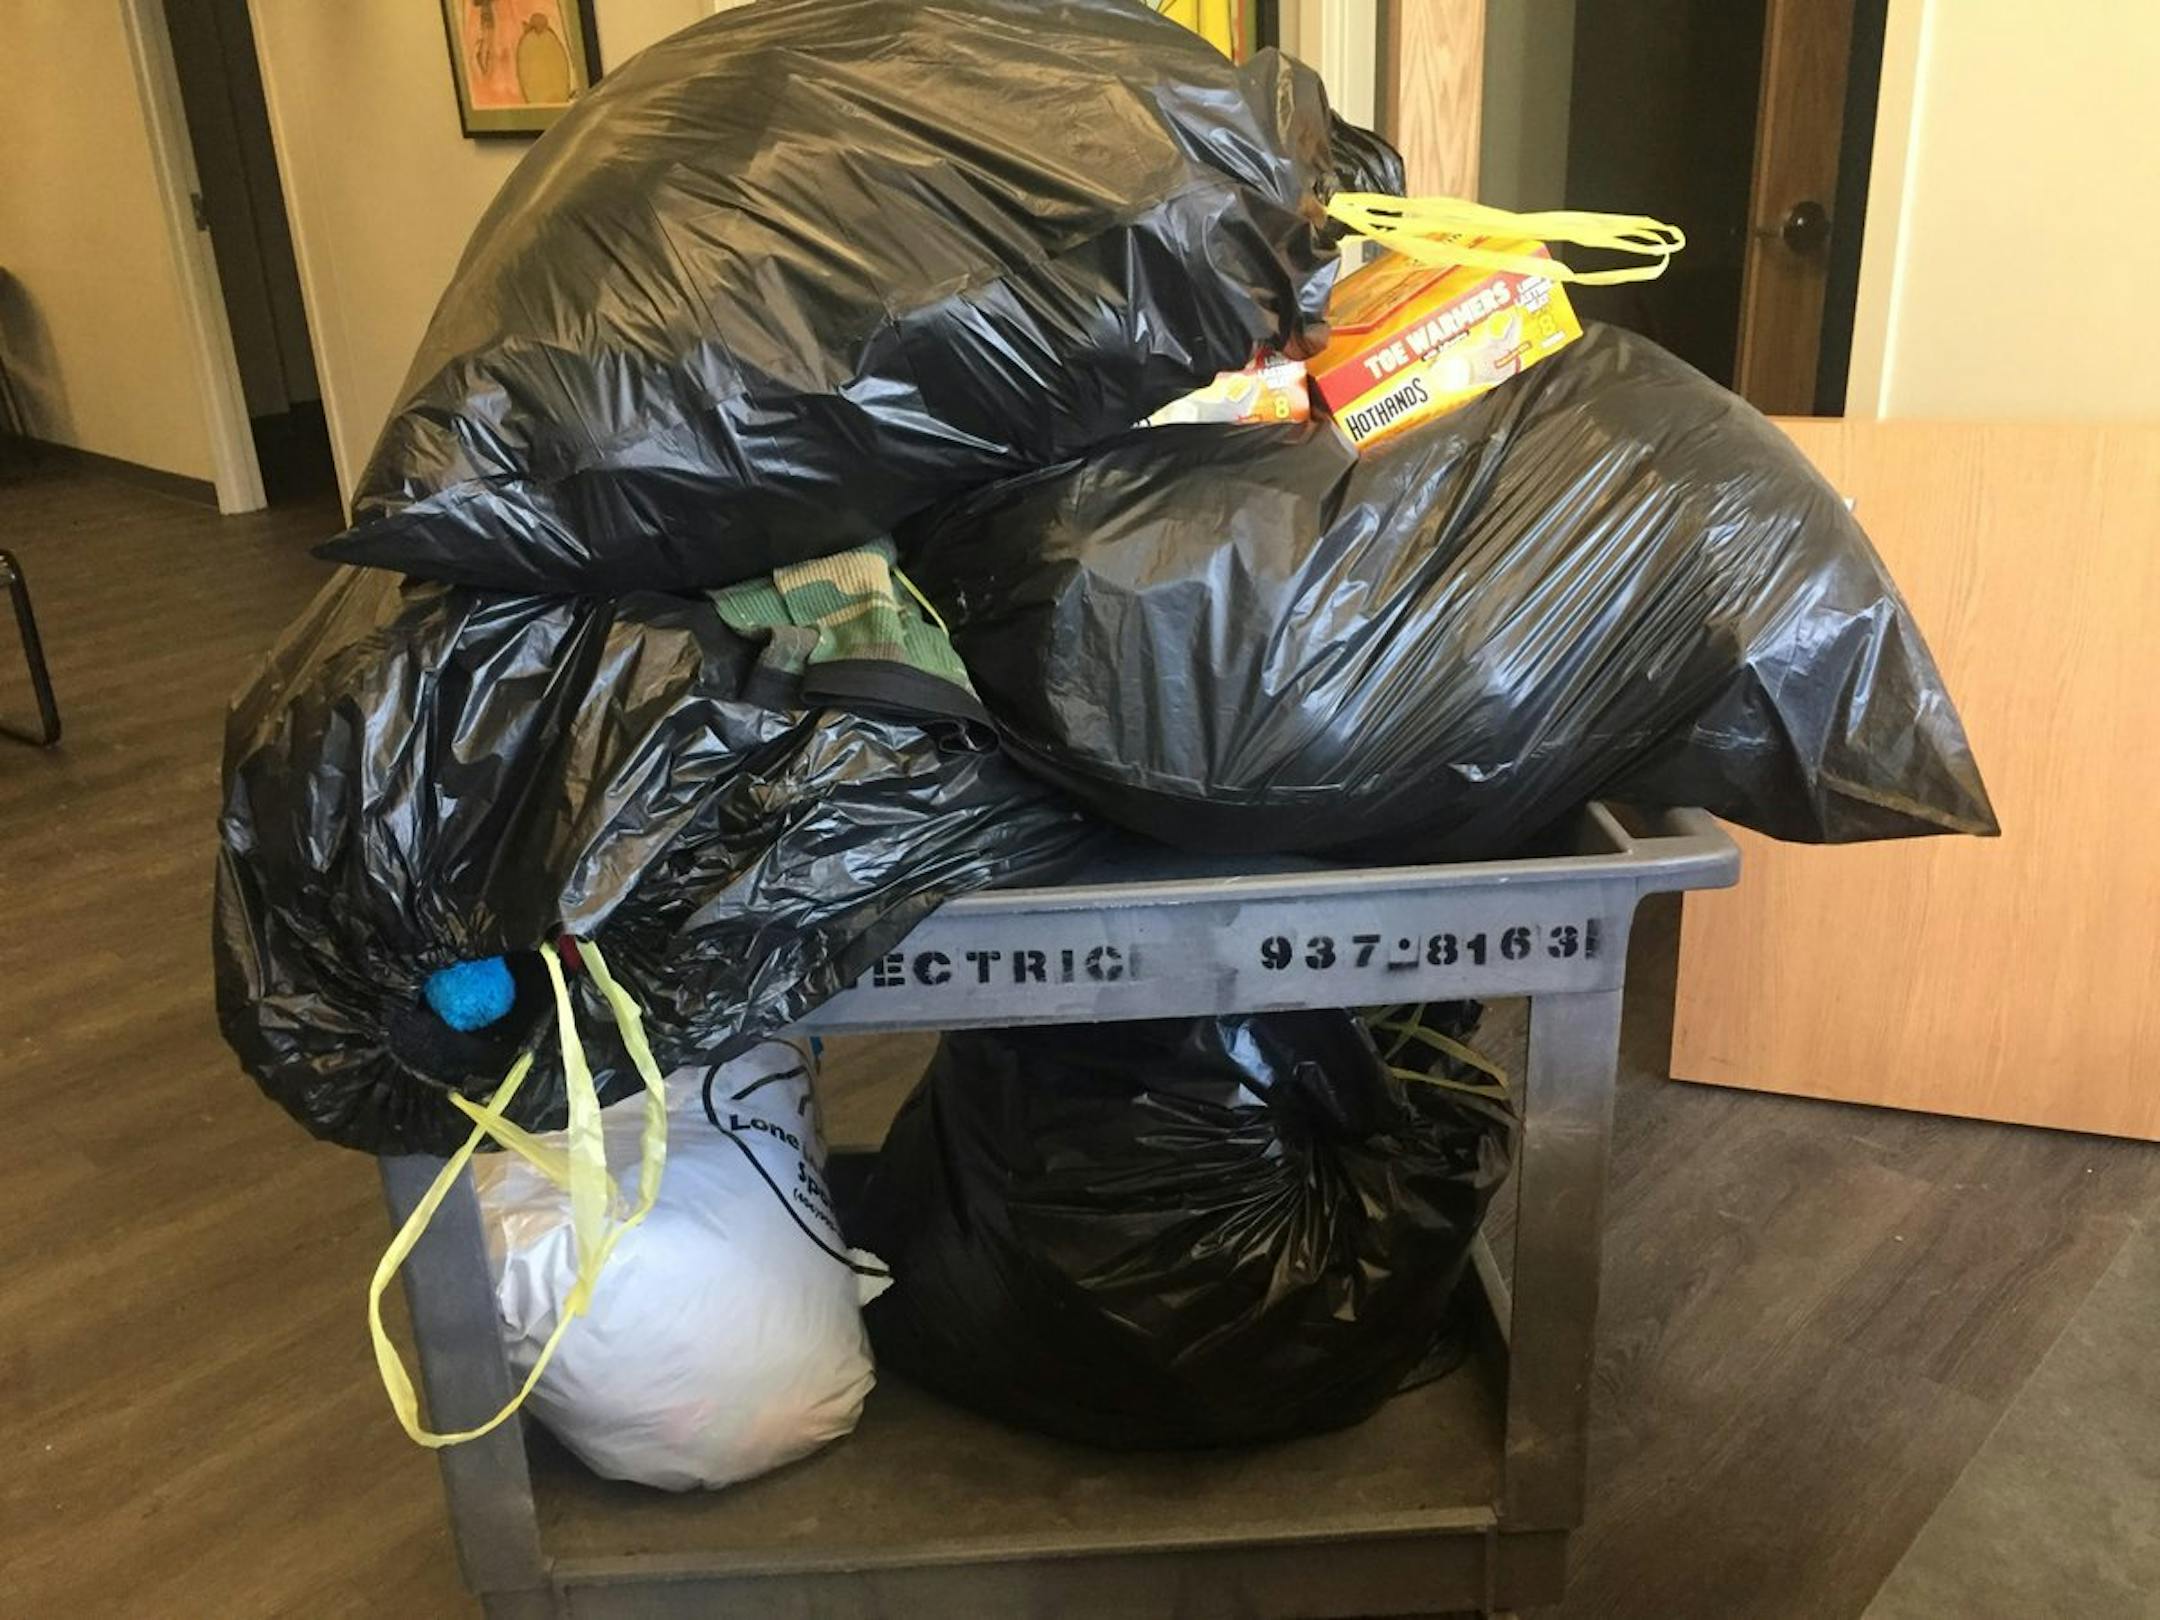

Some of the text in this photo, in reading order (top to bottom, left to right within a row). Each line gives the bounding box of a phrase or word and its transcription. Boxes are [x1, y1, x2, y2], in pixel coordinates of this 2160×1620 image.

[1363, 339, 1410, 380] TOE
[1405, 279, 1512, 354] WARMERS
[1274, 394, 1291, 419] 8
[1345, 376, 1429, 442] HOTHANDS
[845, 945, 1124, 989] ECTRIC
[729, 1113, 801, 1150] Lone
